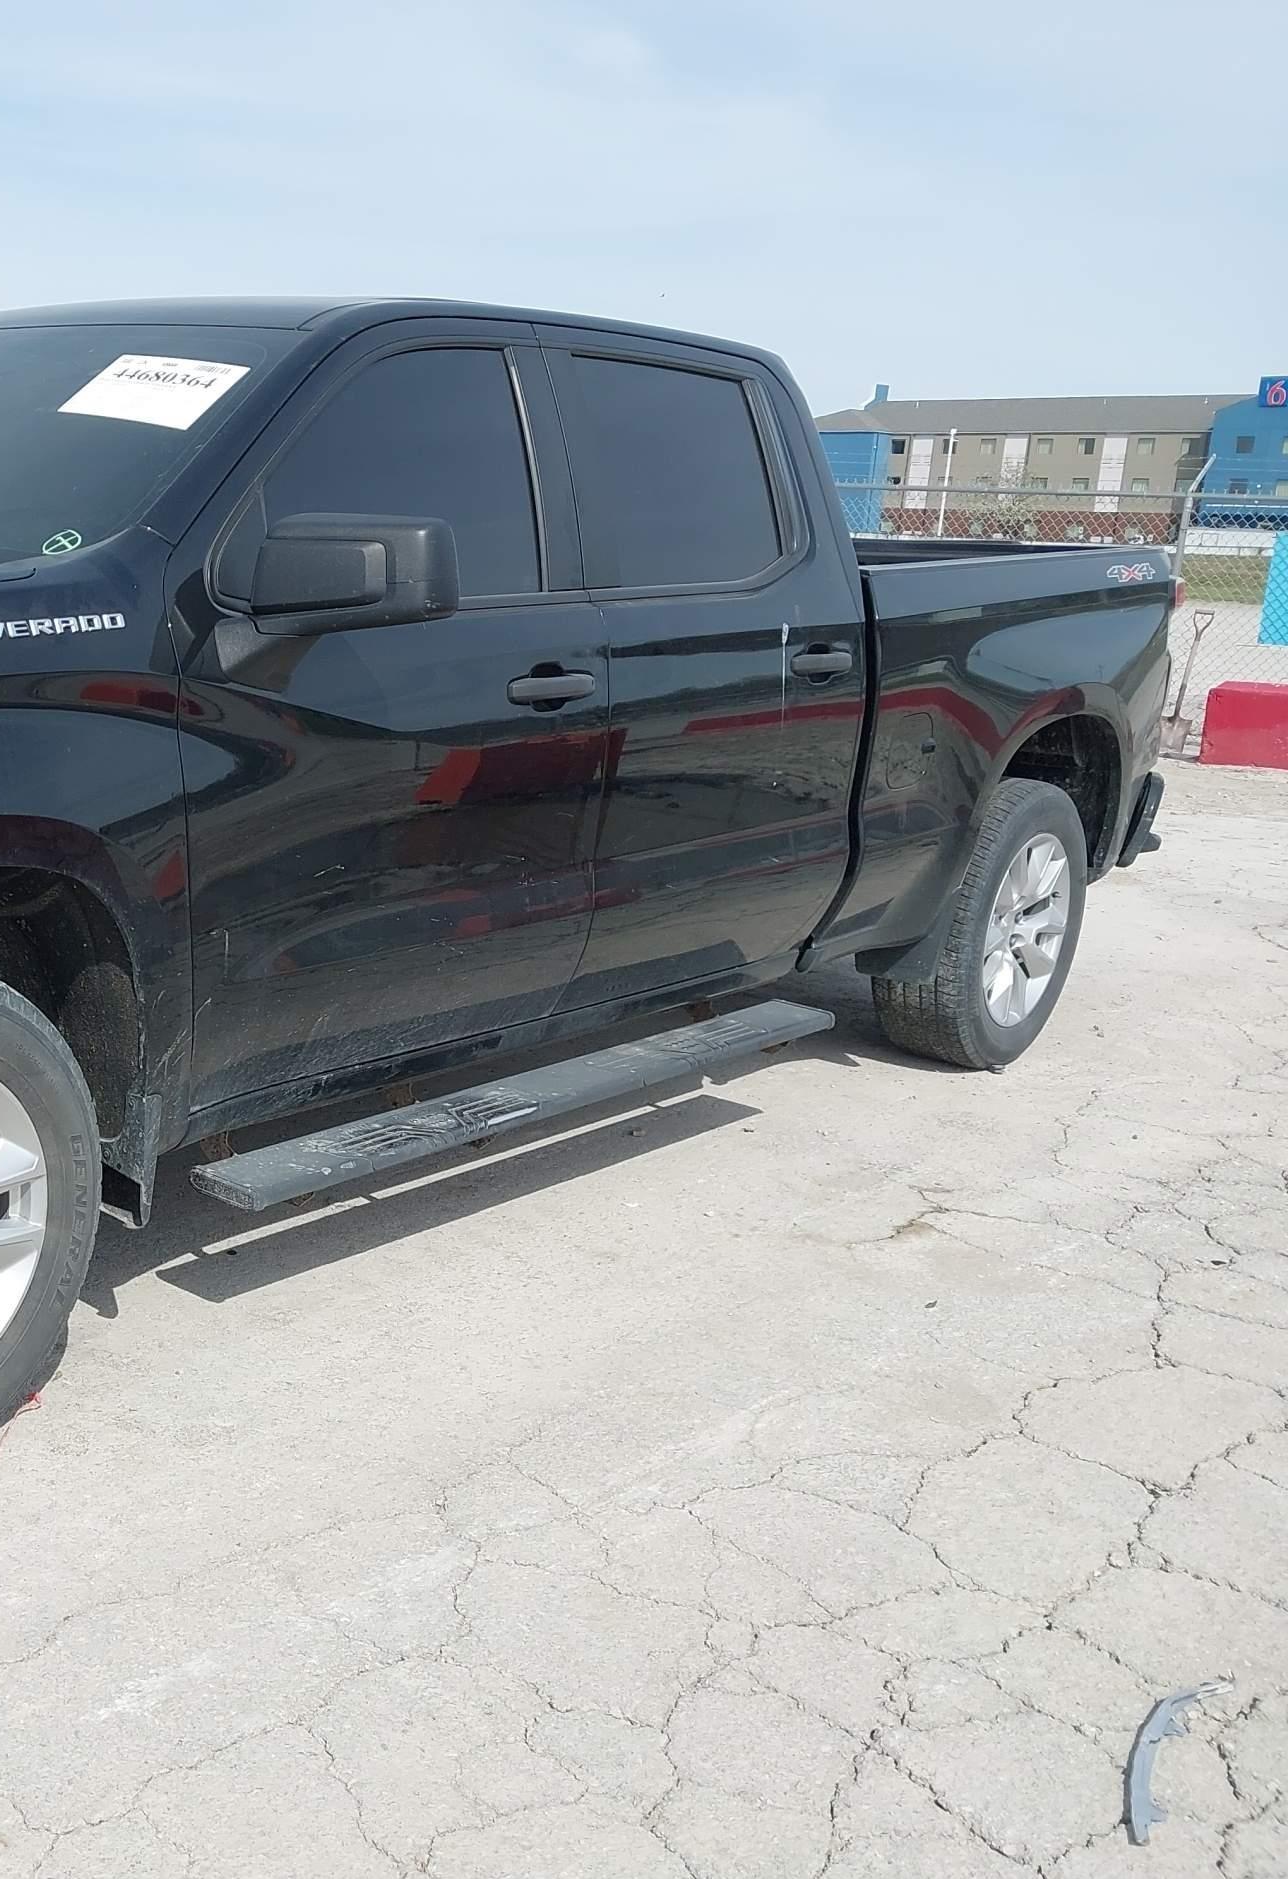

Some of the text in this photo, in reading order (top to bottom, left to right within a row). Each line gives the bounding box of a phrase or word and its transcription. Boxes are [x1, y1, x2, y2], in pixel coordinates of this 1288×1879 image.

[112, 367, 217, 389] 44680364
[1266, 379, 1287, 407] 6
[49, 1133, 88, 1310] GENERAL
